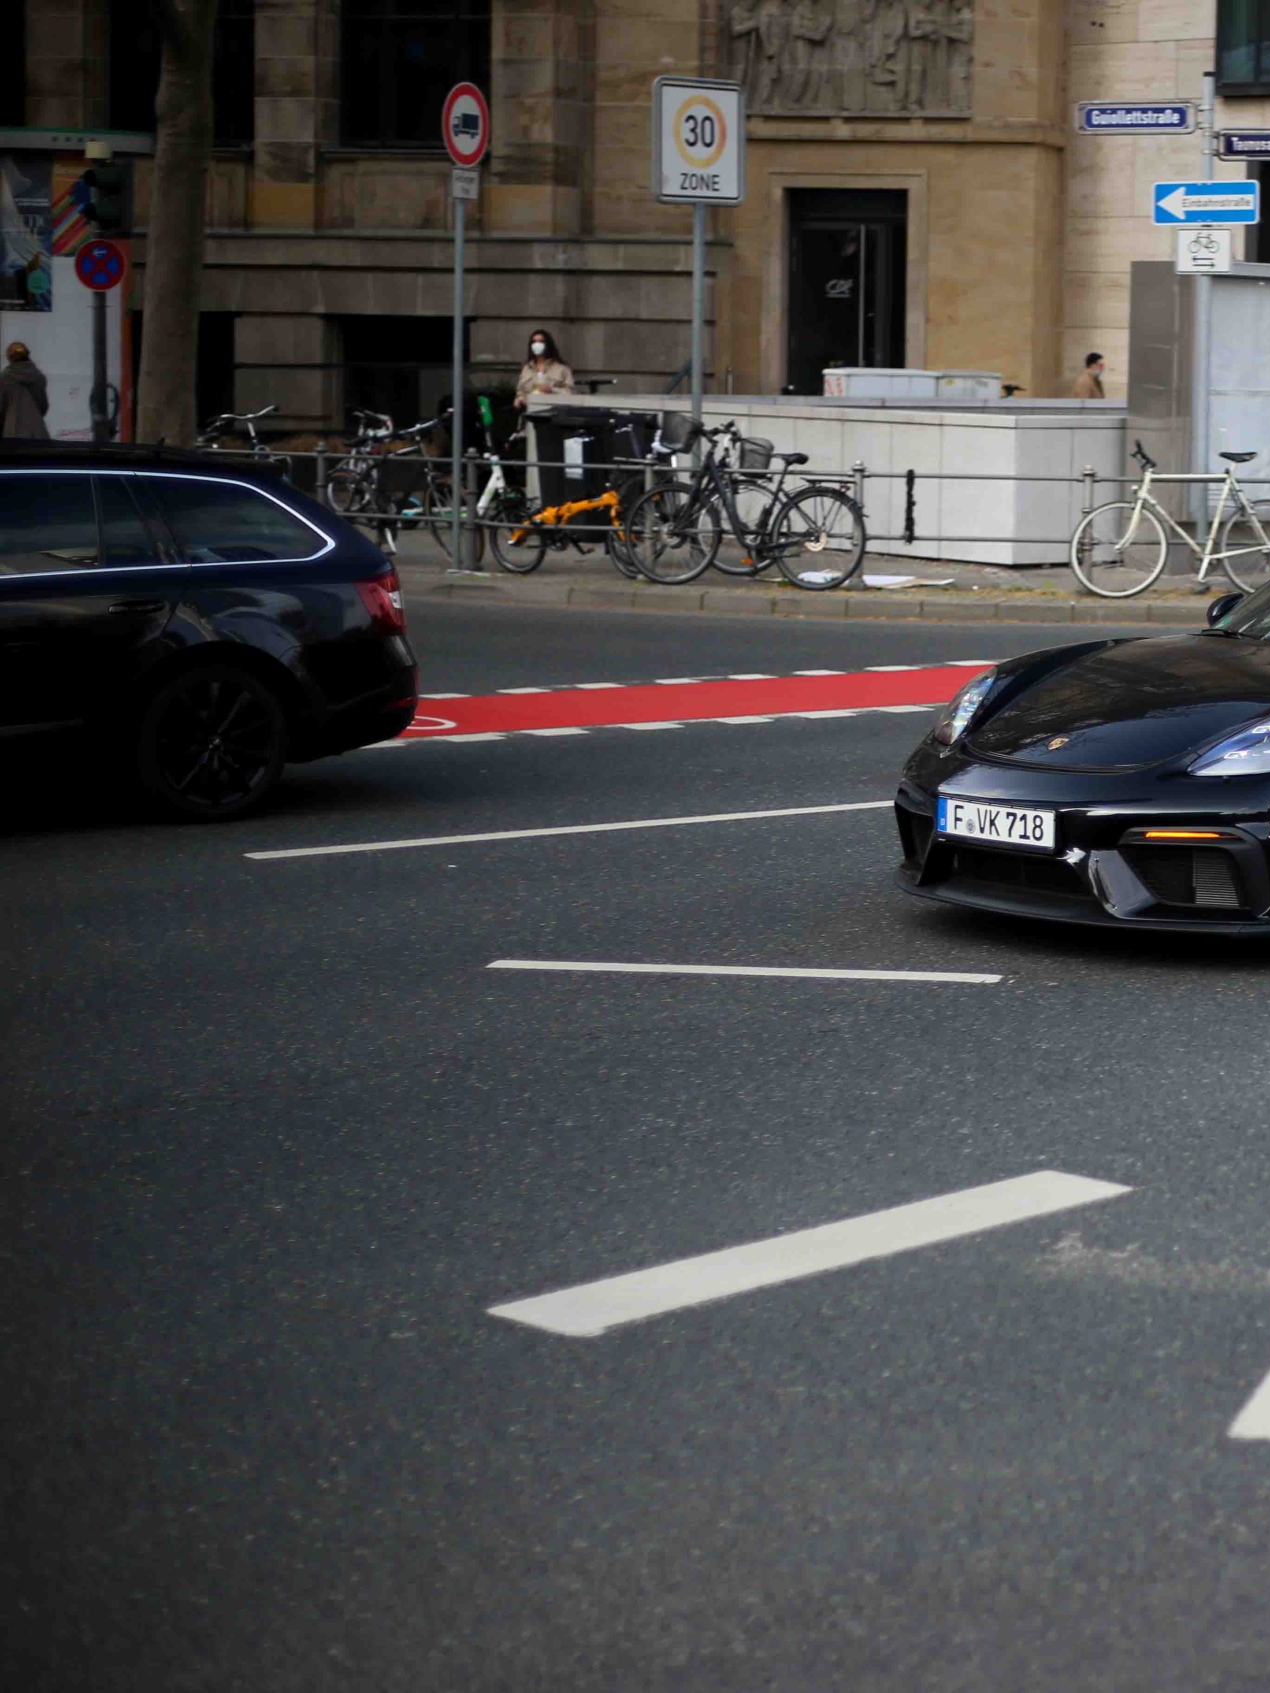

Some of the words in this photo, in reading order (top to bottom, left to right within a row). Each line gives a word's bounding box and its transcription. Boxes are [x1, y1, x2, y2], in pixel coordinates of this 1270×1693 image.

[684, 114, 715, 148] 30
[680, 172, 720, 191] ZONE
[954, 804, 964, 830] F
[976, 807, 1000, 836] VK
[1005, 811, 1044, 842] 718
